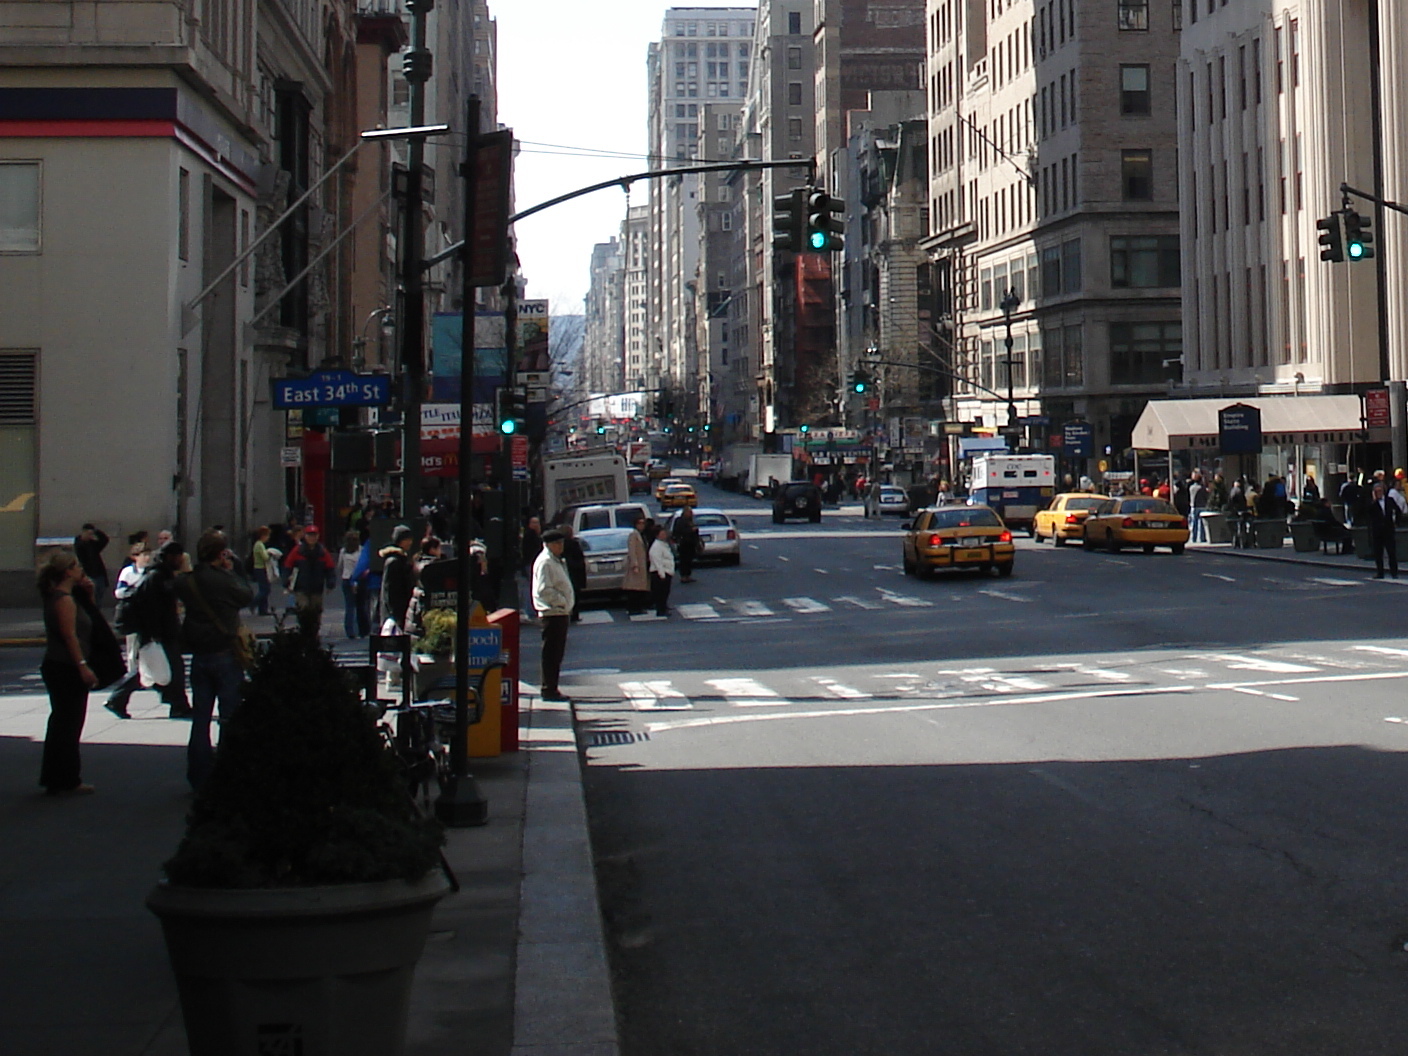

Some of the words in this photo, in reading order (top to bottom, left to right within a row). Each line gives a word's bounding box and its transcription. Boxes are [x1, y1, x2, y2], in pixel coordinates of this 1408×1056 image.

[519, 304, 545, 314] NYC
[283, 387, 319, 402] East
[325, 383, 358, 400] 34th
[363, 384, 380, 400] St
[469, 631, 499, 648] poch
